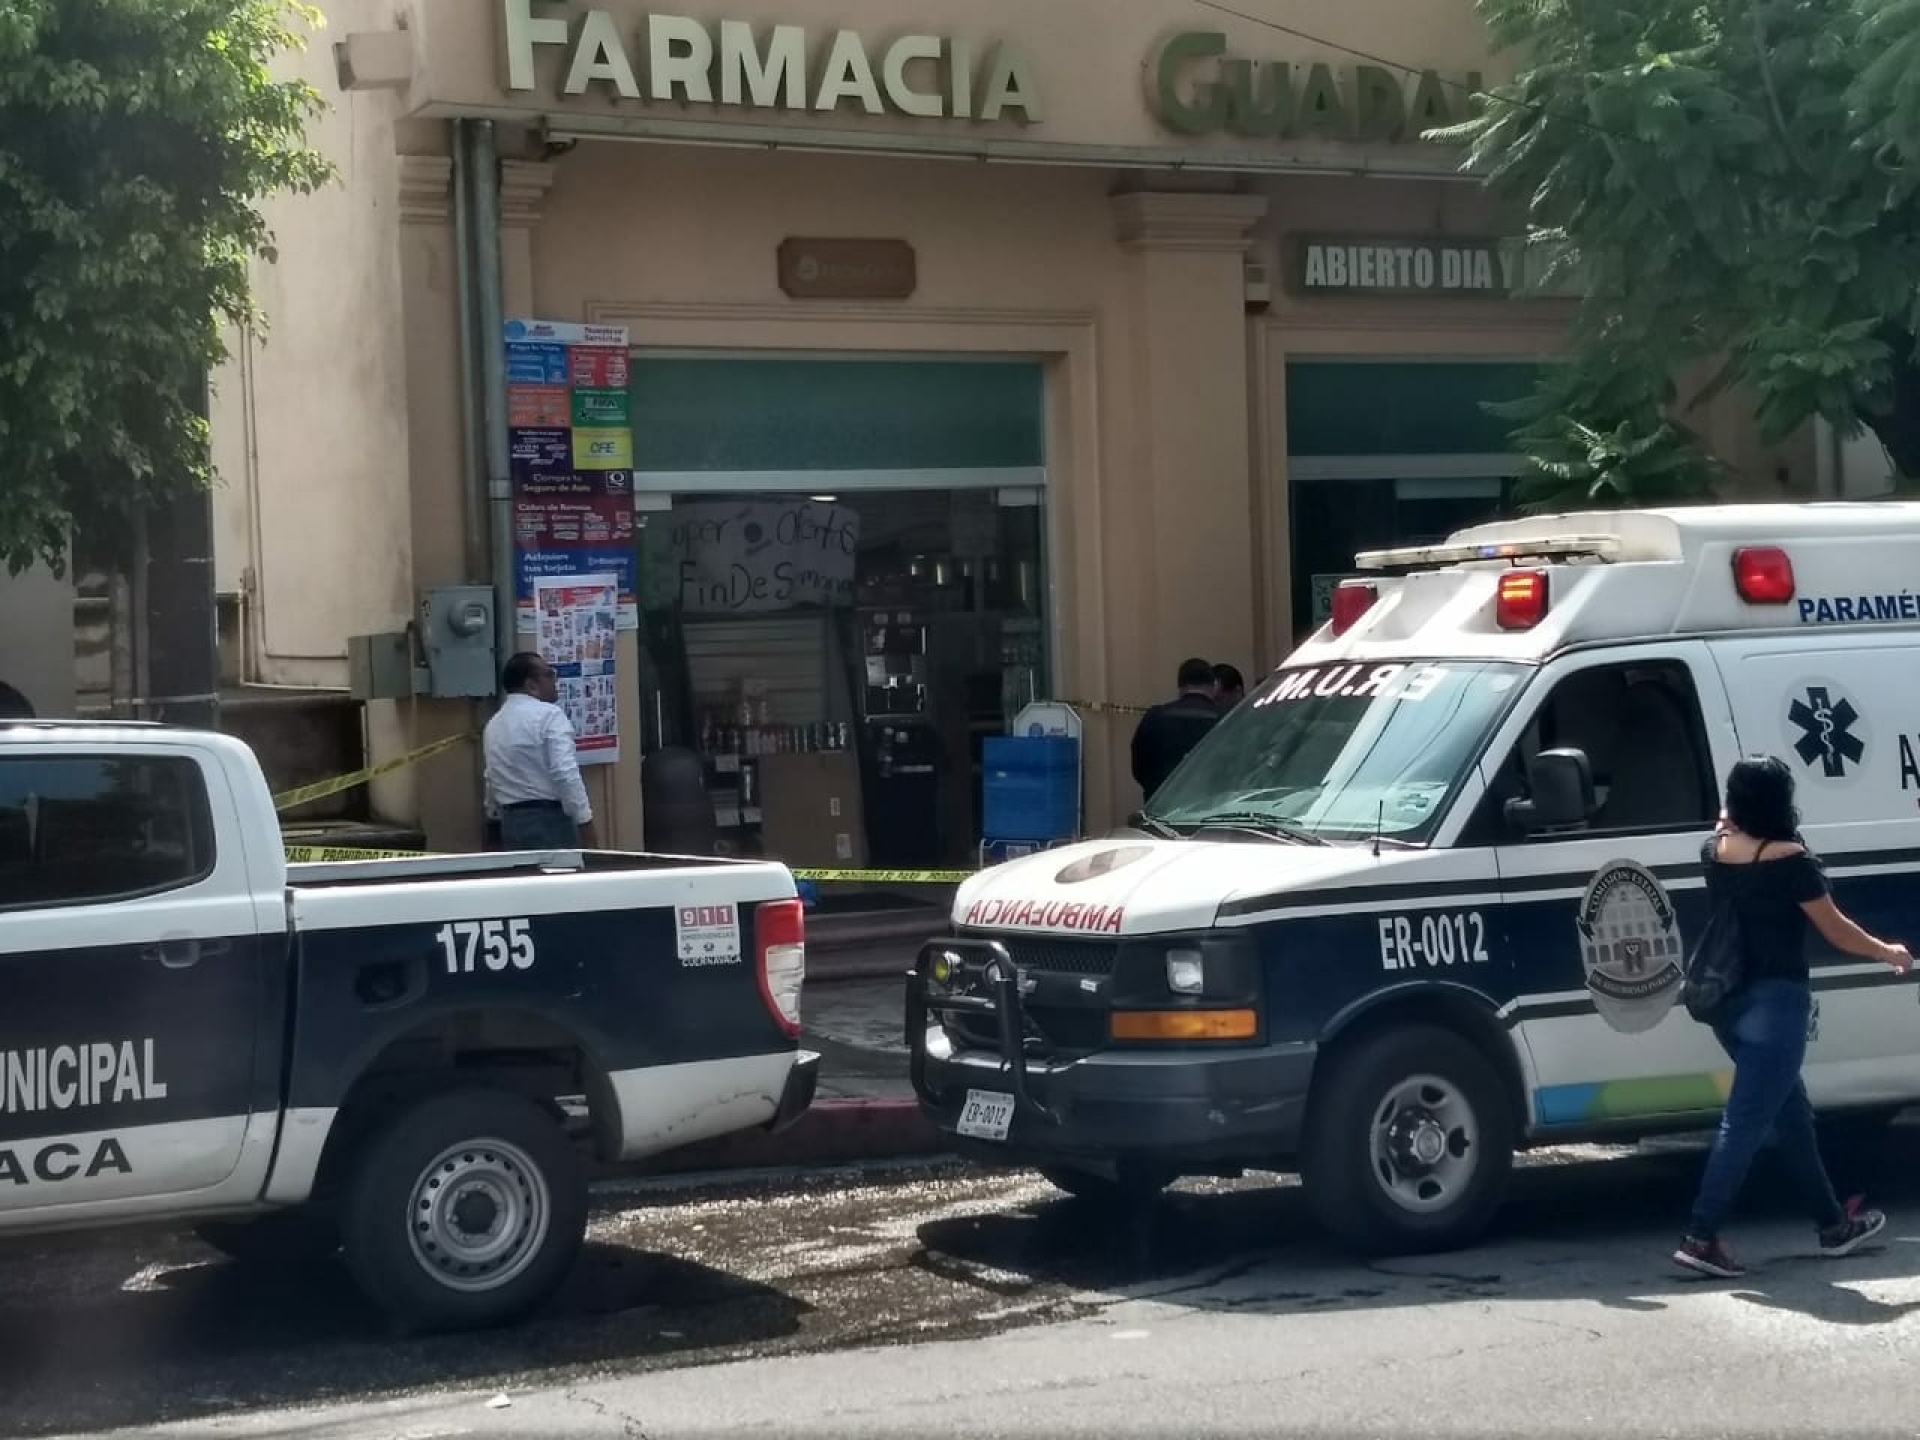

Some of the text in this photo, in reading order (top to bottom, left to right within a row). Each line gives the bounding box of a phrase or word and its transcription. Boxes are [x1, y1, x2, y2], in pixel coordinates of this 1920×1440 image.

[506, 0, 1043, 122] FARMACIA
[1305, 246, 1434, 288] ABIERTO
[1441, 249, 1492, 288] DIA
[1498, 250, 1514, 288] Y
[590, 442, 615, 454] CFE
[1799, 588, 1920, 622] PARAMÉ
[683, 907, 732, 925] 911
[1378, 911, 1489, 970] ER-0012
[436, 917, 535, 973] 1755
[0, 1038, 167, 1114] NICIPAL
